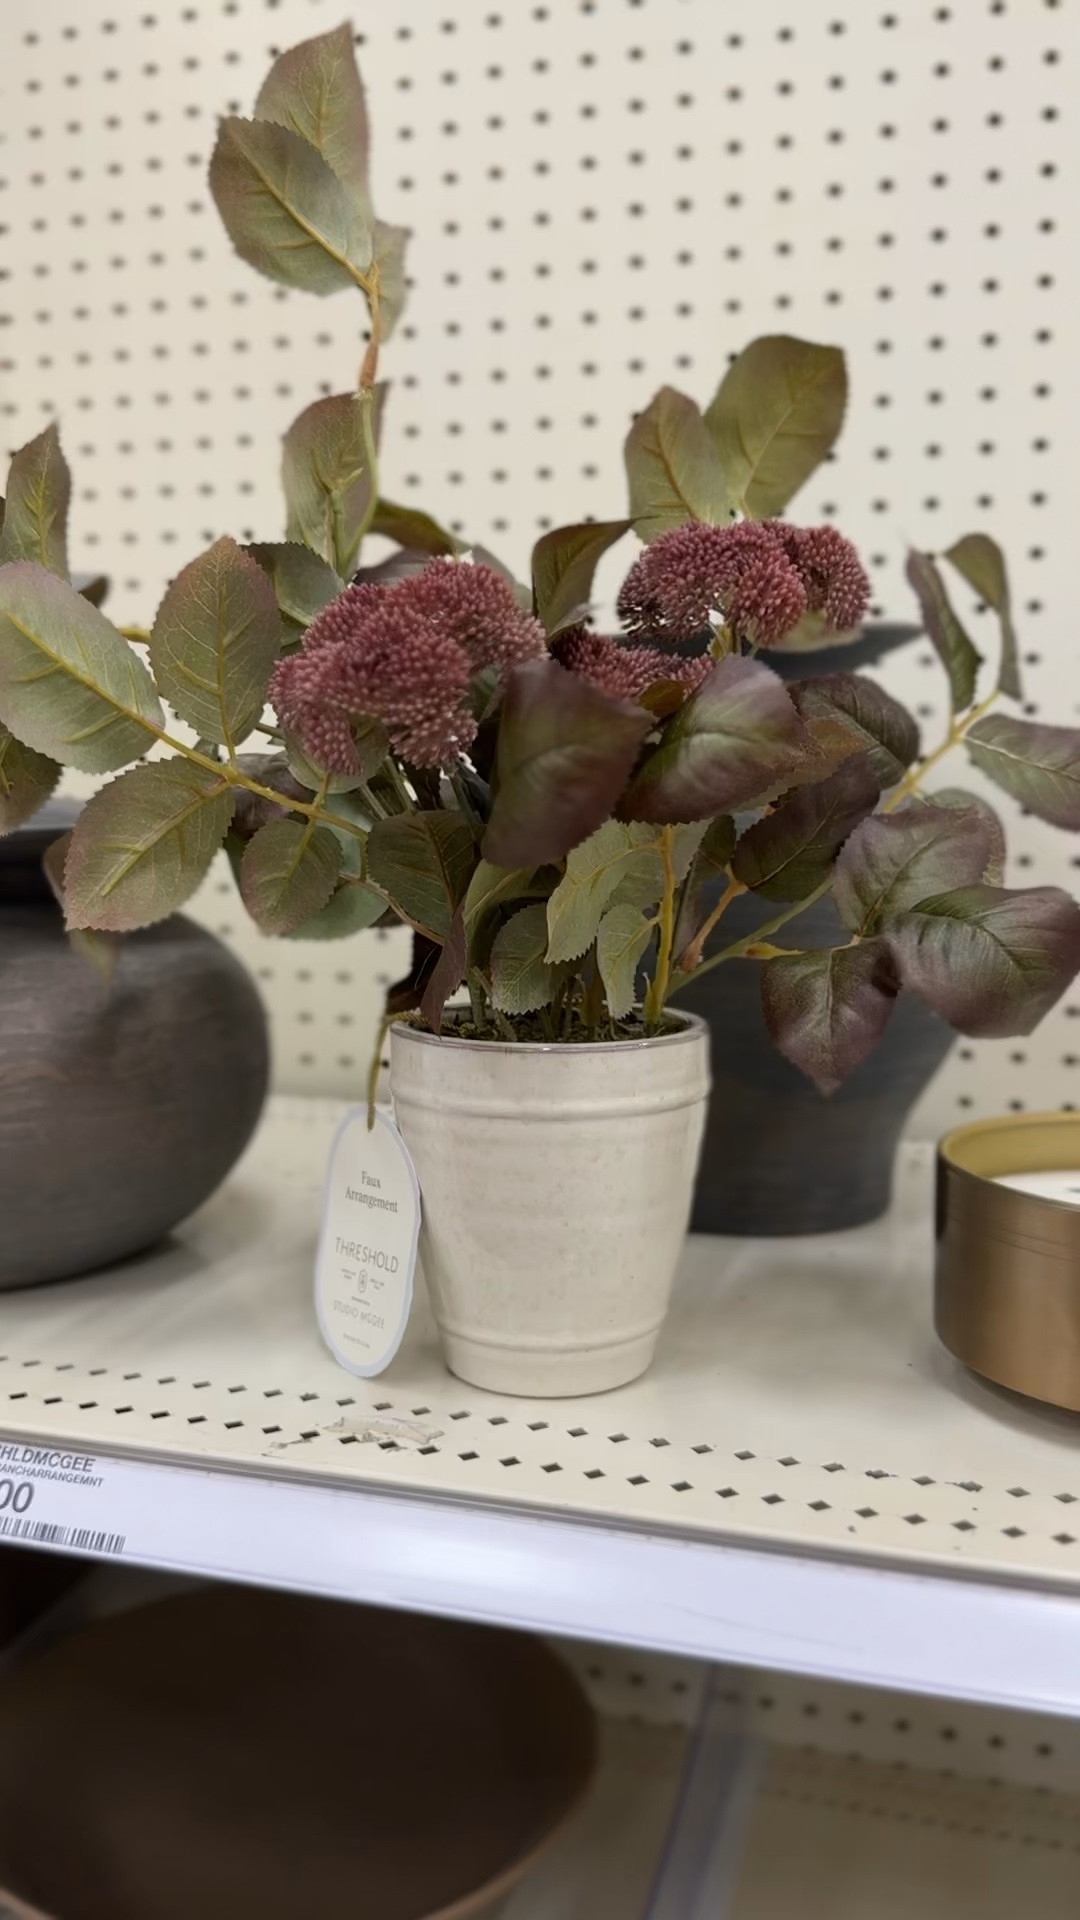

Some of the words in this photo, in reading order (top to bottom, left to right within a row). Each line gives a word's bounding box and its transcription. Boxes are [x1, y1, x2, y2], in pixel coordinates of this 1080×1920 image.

[361, 1170, 381, 1188] Faux
[345, 1186, 398, 1213] Arrangement
[336, 1236, 399, 1273] THRESHOLD
[0, 1444, 96, 1473] HLDMCGEE
[0, 1463, 104, 1487] ANCHARRANGEMNT
